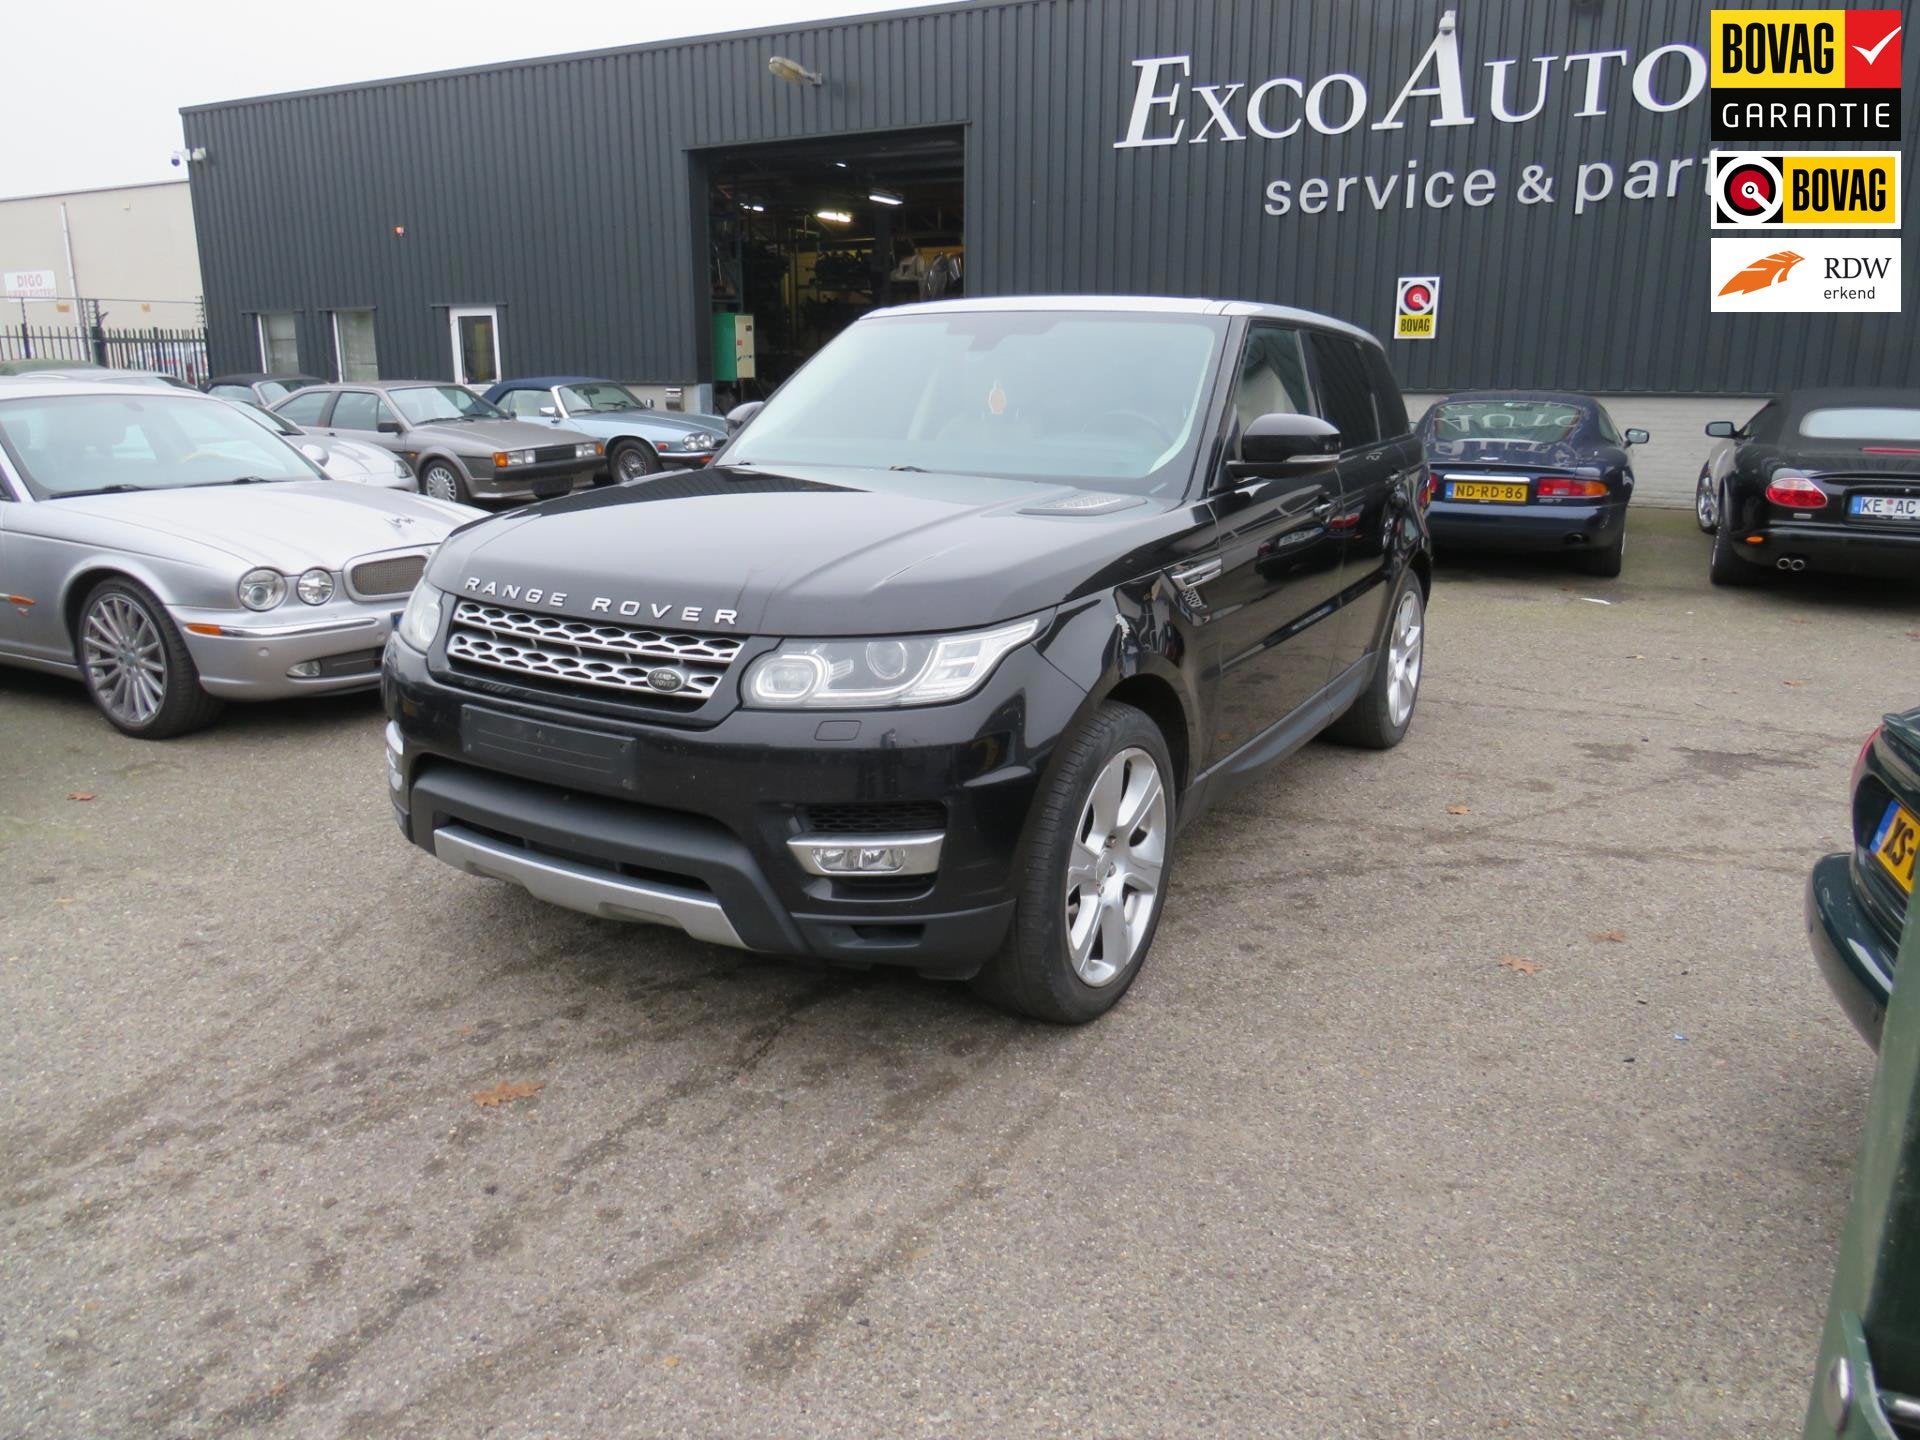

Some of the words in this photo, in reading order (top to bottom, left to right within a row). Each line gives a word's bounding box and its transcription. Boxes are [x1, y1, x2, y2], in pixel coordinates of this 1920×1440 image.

[1264, 159, 1497, 216] service
[1517, 164, 1554, 205] &
[1400, 318, 1430, 332] BOVAG
[1455, 484, 1523, 500] ND-RD-86
[1861, 499, 1883, 513] KE
[1895, 500, 1916, 515] AC
[465, 576, 568, 606] RANGE
[591, 596, 738, 625] ROVER
[1882, 817, 1915, 881] XS-
